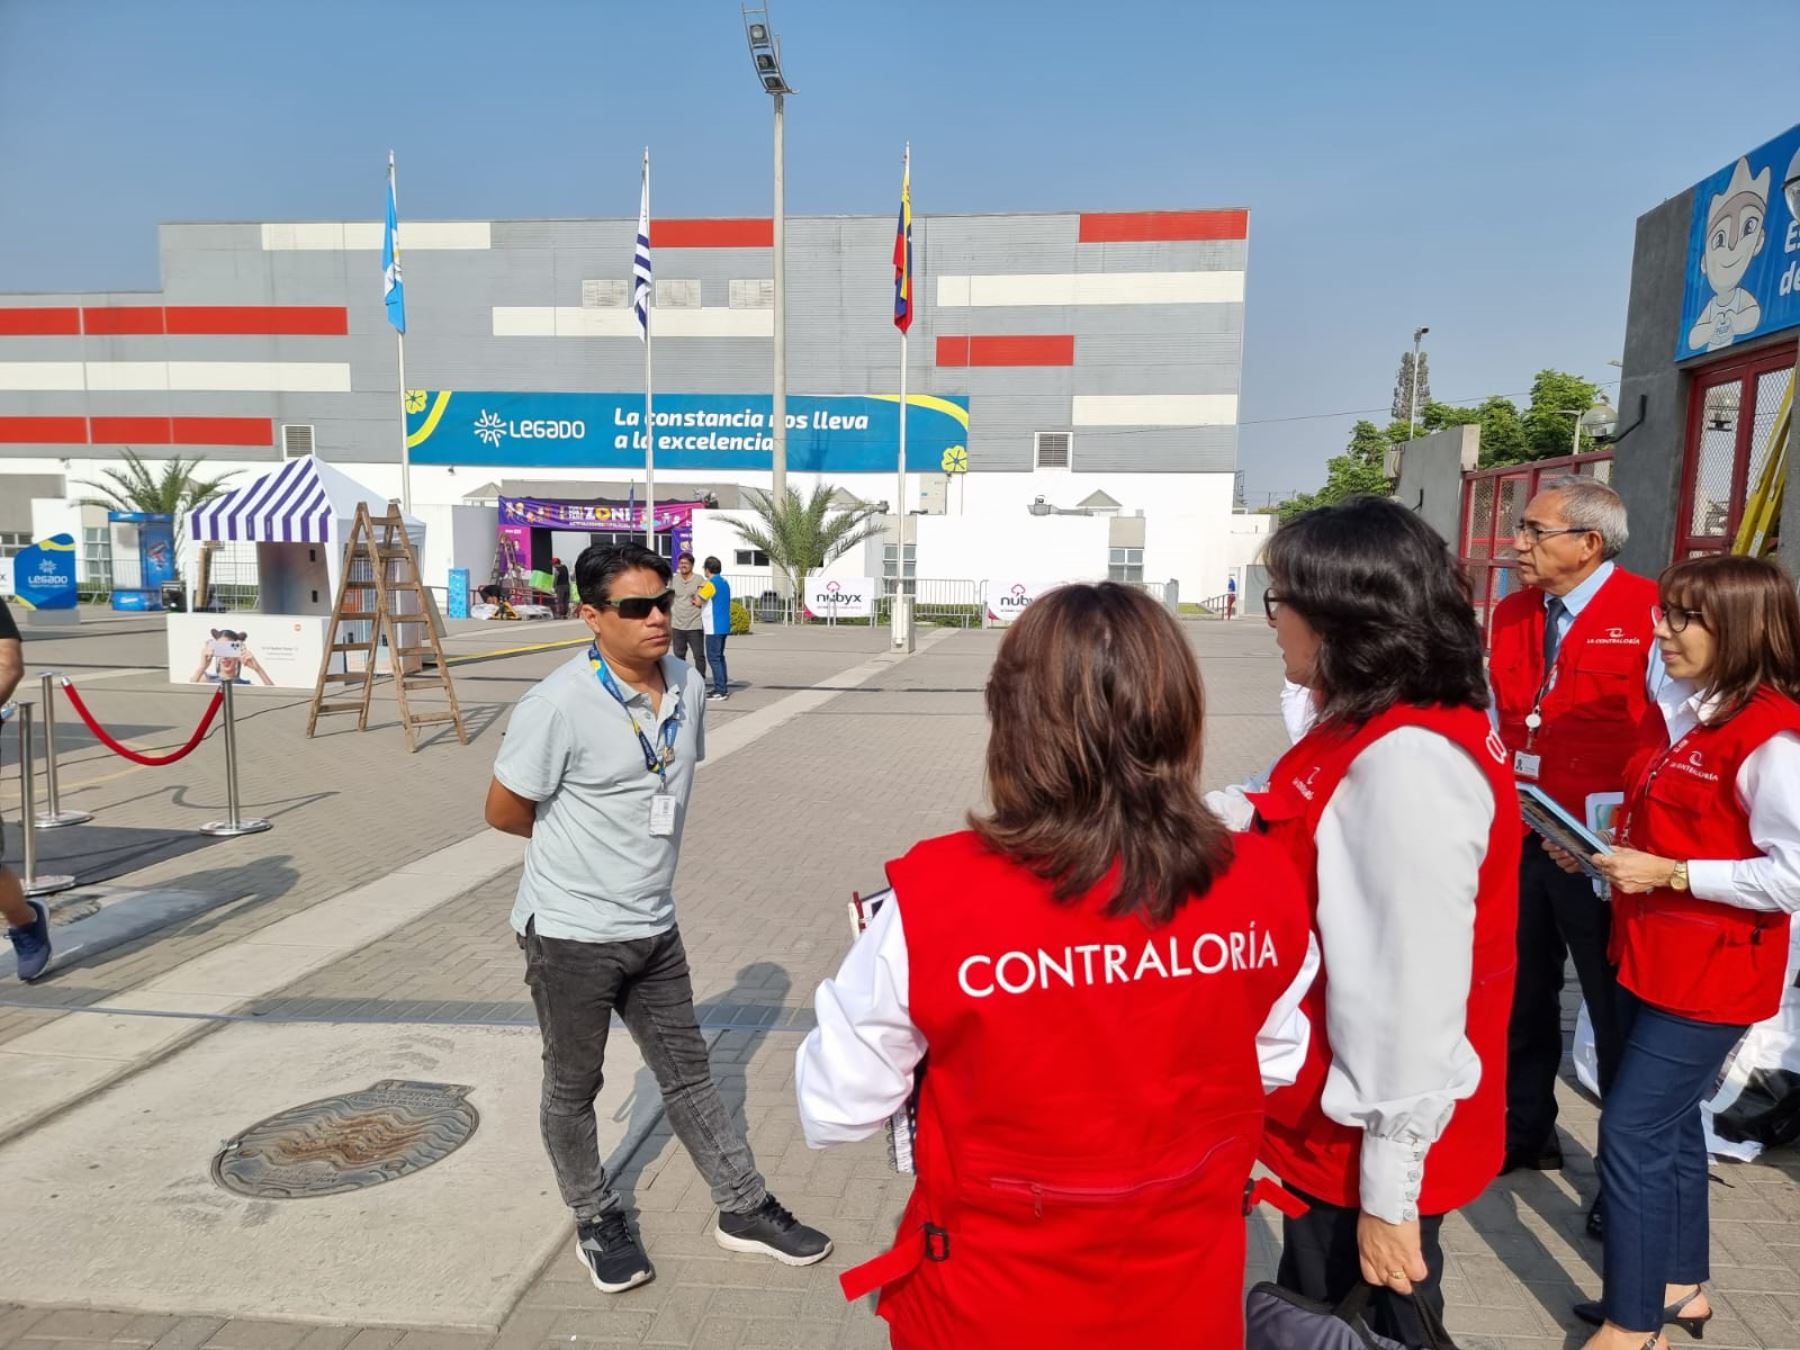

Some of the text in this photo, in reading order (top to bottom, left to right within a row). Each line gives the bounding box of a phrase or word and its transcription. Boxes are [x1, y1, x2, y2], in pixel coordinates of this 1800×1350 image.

[1784, 219, 1800, 254] E
[614, 407, 639, 427] La
[644, 408, 764, 428] constancia
[812, 411, 869, 430] lleva
[614, 437, 628, 450] a
[658, 432, 774, 451] excelencia
[816, 591, 863, 606] nubyx
[1000, 594, 1033, 607] nub
[957, 920, 1279, 998] CONTRALORÍA
